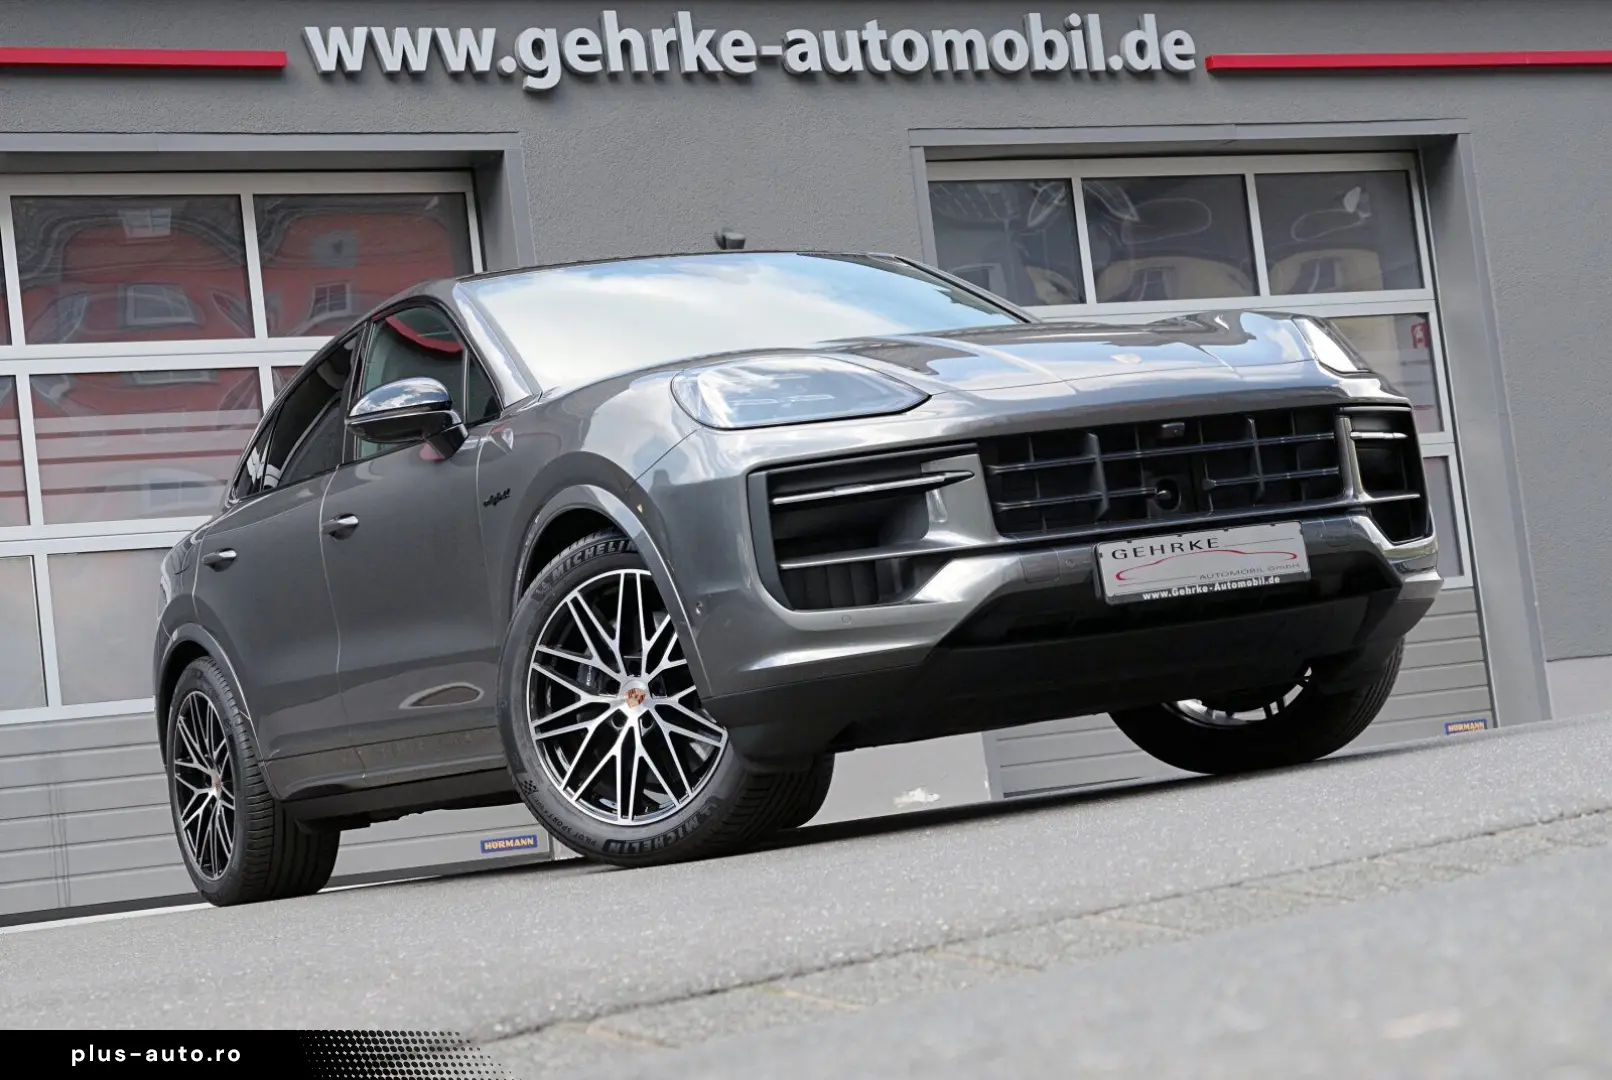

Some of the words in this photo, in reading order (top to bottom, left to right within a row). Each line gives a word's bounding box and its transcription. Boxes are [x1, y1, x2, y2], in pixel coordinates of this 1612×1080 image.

[303, 9, 1196, 91] www.gehrke-automobil.de
[551, 540, 638, 582] MICHELIN
[1112, 537, 1219, 560] GEHRKE
[1199, 567, 1263, 580] AUTOMOBIL
[1142, 575, 1280, 601] www.Gehrke-Automobil.de
